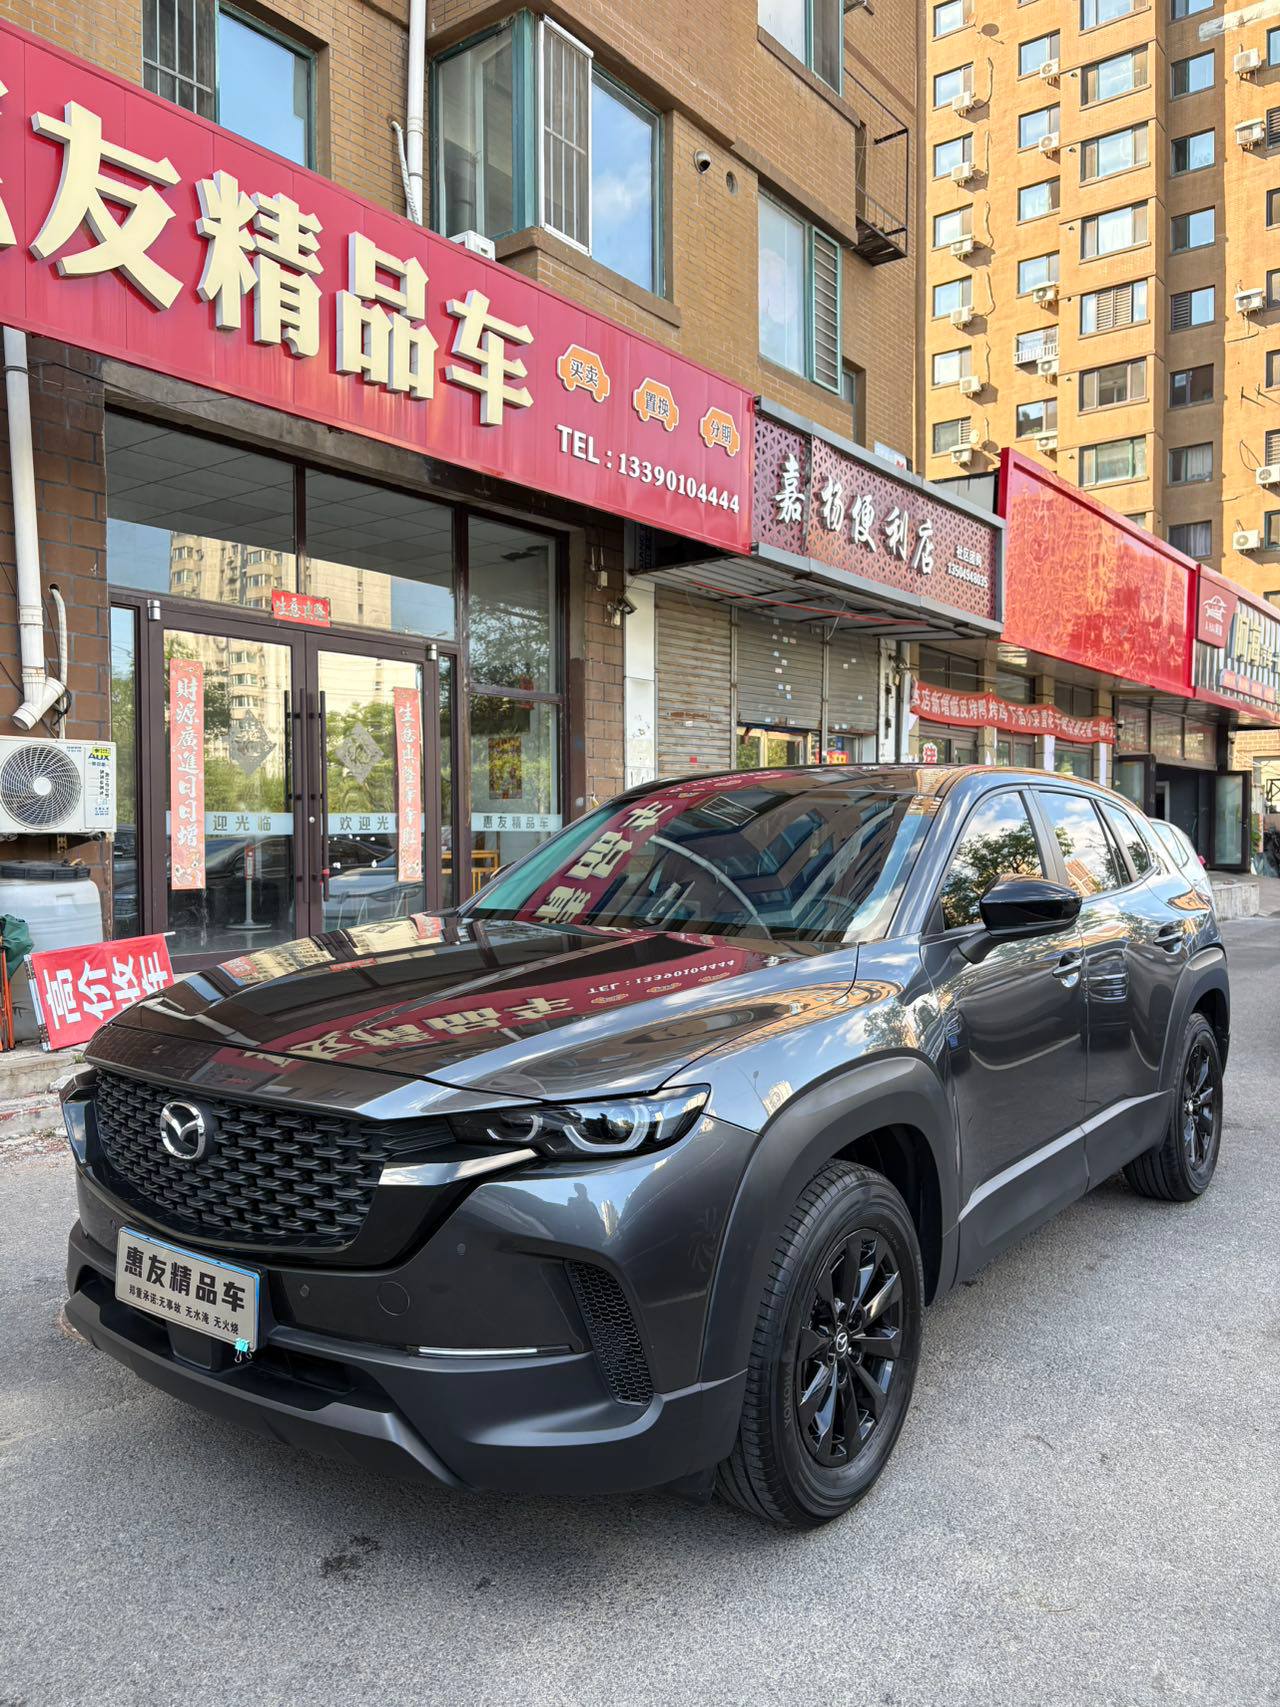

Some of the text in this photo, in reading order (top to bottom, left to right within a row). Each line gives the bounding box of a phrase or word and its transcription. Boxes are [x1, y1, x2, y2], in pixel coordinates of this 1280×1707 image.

[0, 80, 535, 426] 友精品车
[569, 358, 598, 387] 买卖
[645, 391, 669, 417] 置换
[710, 420, 732, 443] 分期
[483, 815, 550, 829] 惠友精品车
[124, 1246, 245, 1312] 惠友精品车
